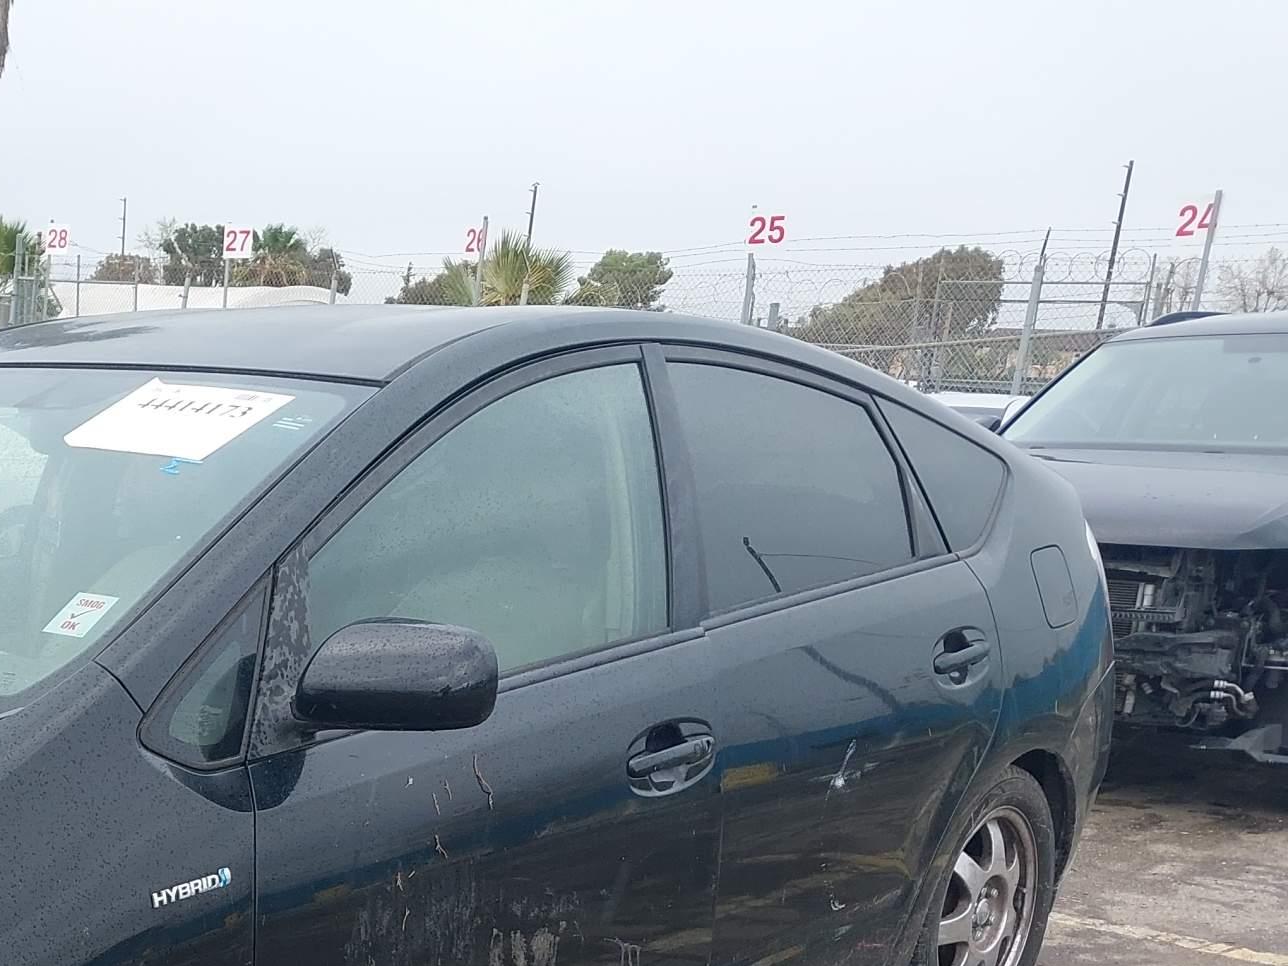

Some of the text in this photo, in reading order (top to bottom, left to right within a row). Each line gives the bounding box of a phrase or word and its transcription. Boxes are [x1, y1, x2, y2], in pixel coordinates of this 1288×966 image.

[748, 215, 785, 244] 25
[1175, 203, 1217, 237] 24
[48, 229, 68, 249] 28
[225, 229, 251, 252] 27
[76, 598, 106, 610] SMOG
[60, 620, 80, 631] OK
[152, 874, 220, 908] HYBRID
